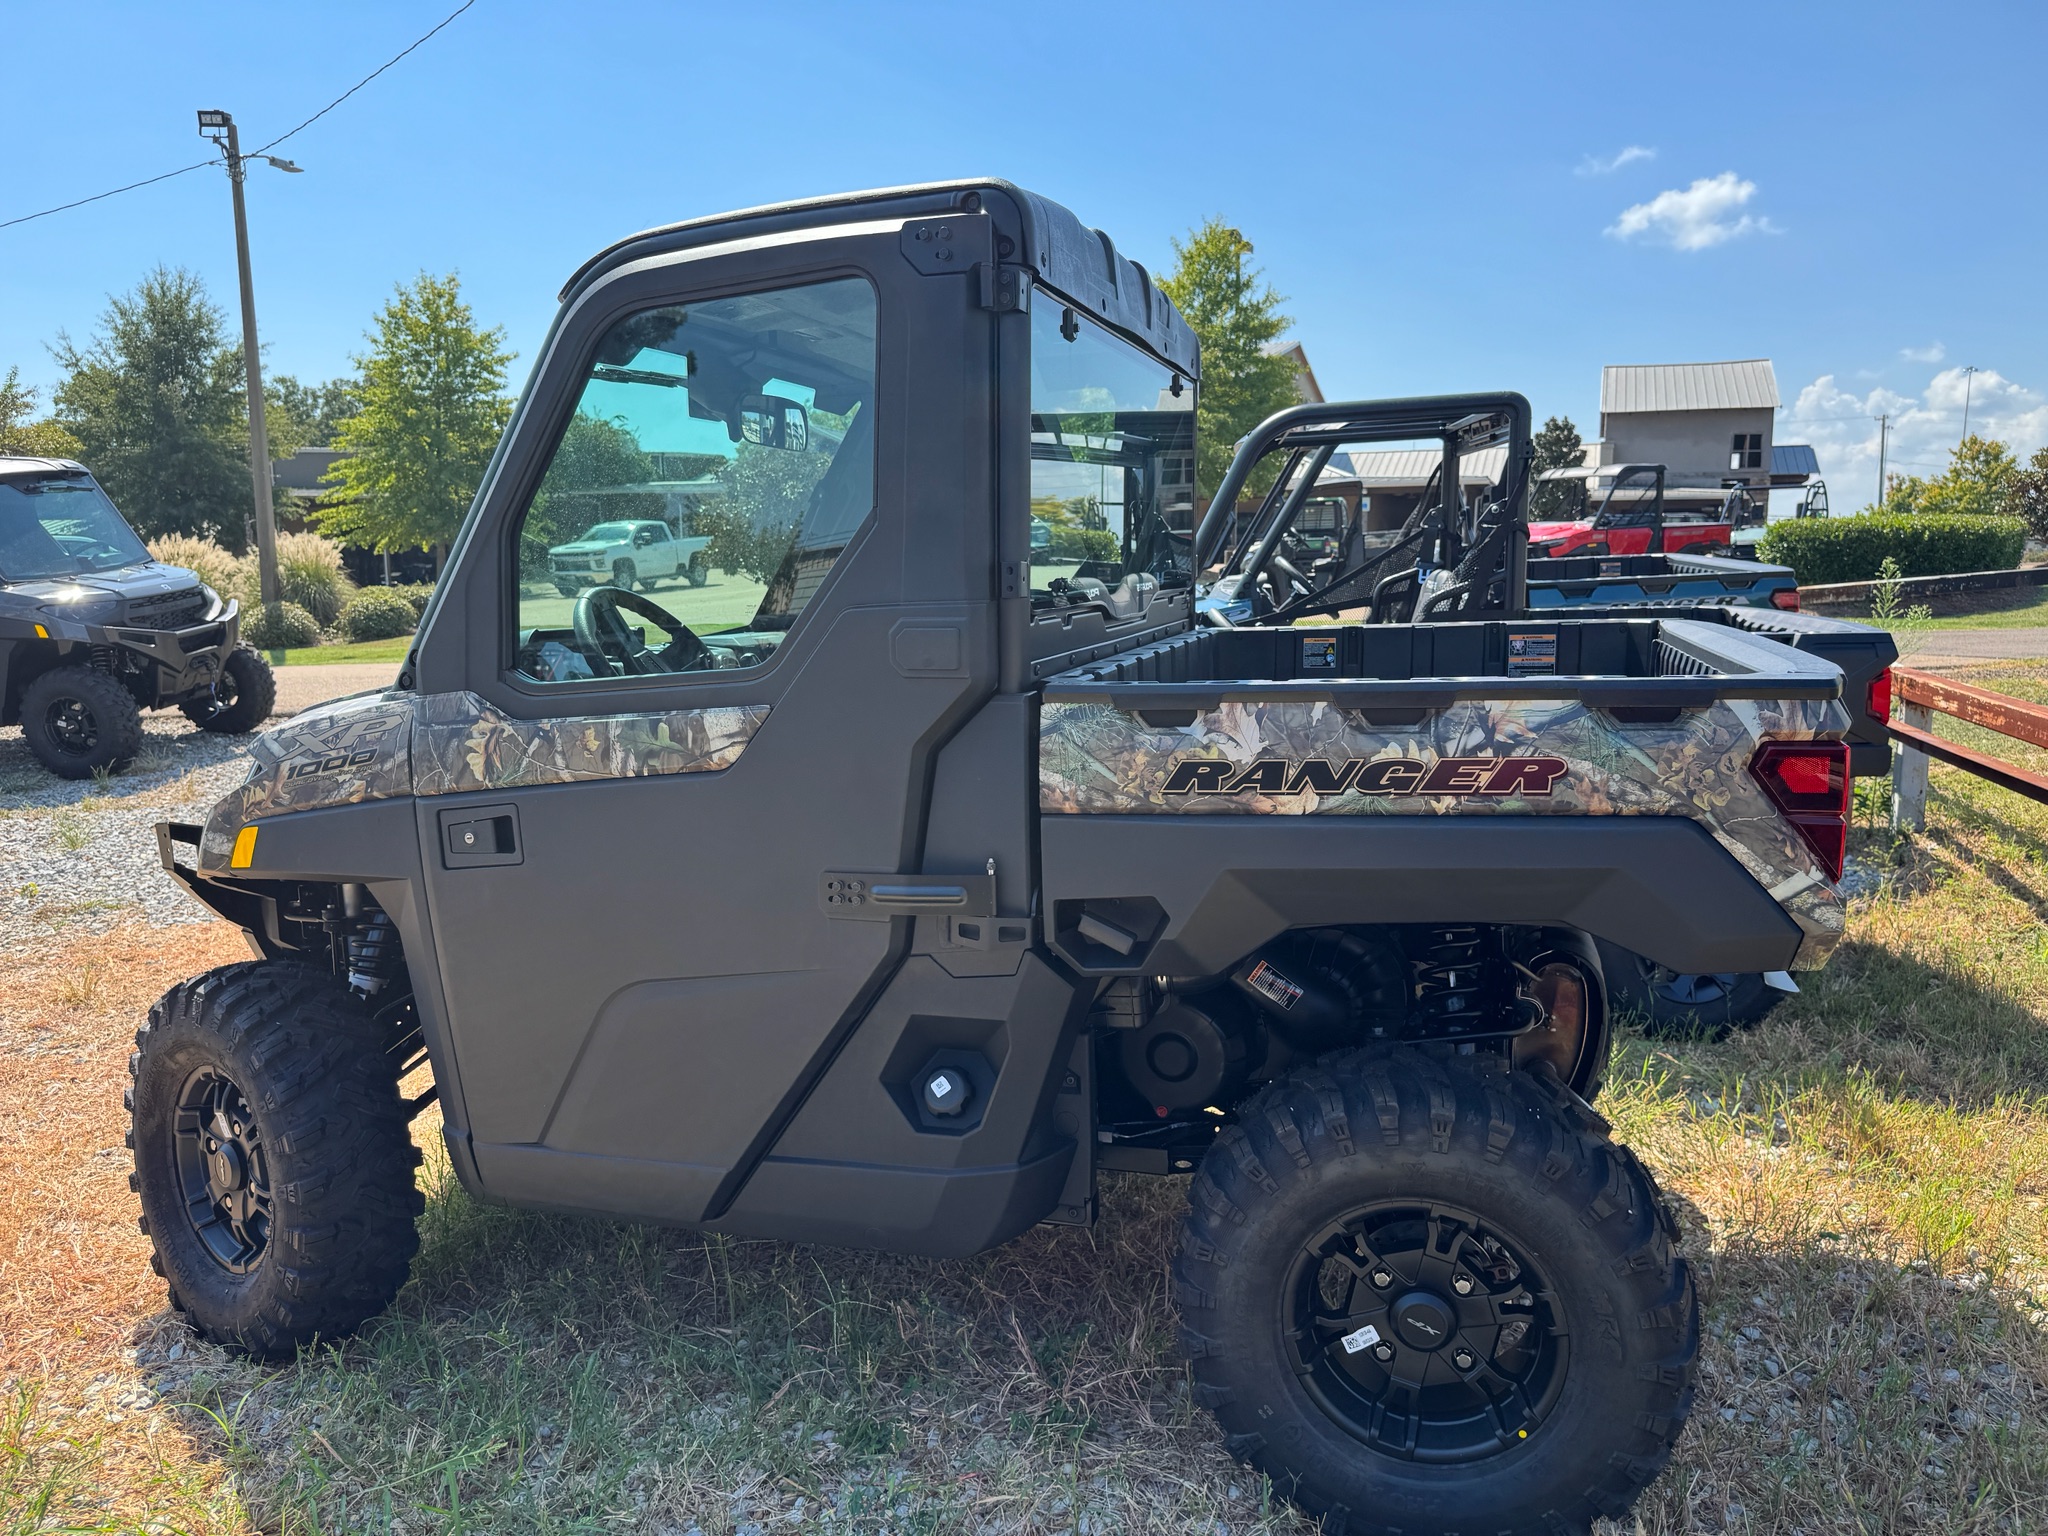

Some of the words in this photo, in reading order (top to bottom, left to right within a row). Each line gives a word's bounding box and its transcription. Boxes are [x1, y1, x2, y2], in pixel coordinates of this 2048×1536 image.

[272, 713, 404, 763] XP
[286, 748, 379, 781] 1000
[1159, 756, 1568, 796] RANGER
